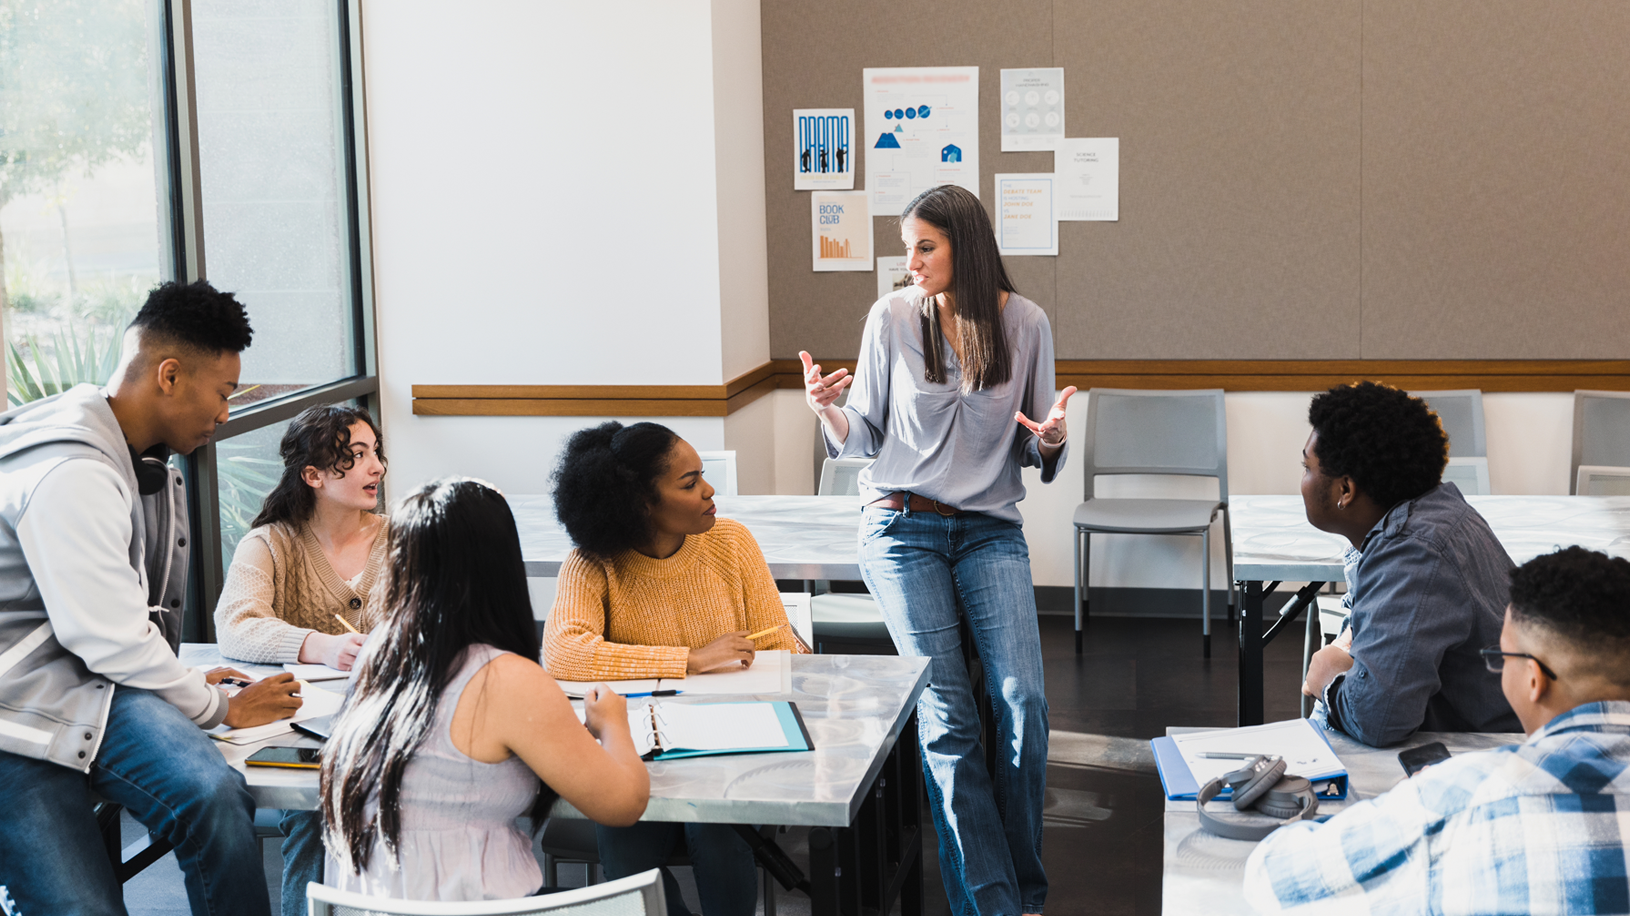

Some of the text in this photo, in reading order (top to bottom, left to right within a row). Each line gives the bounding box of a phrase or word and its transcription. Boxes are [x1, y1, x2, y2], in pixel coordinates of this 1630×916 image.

[798, 116, 849, 173] DRAMA
[819, 204, 844, 214] BOOK
[819, 215, 840, 225] CLUB
